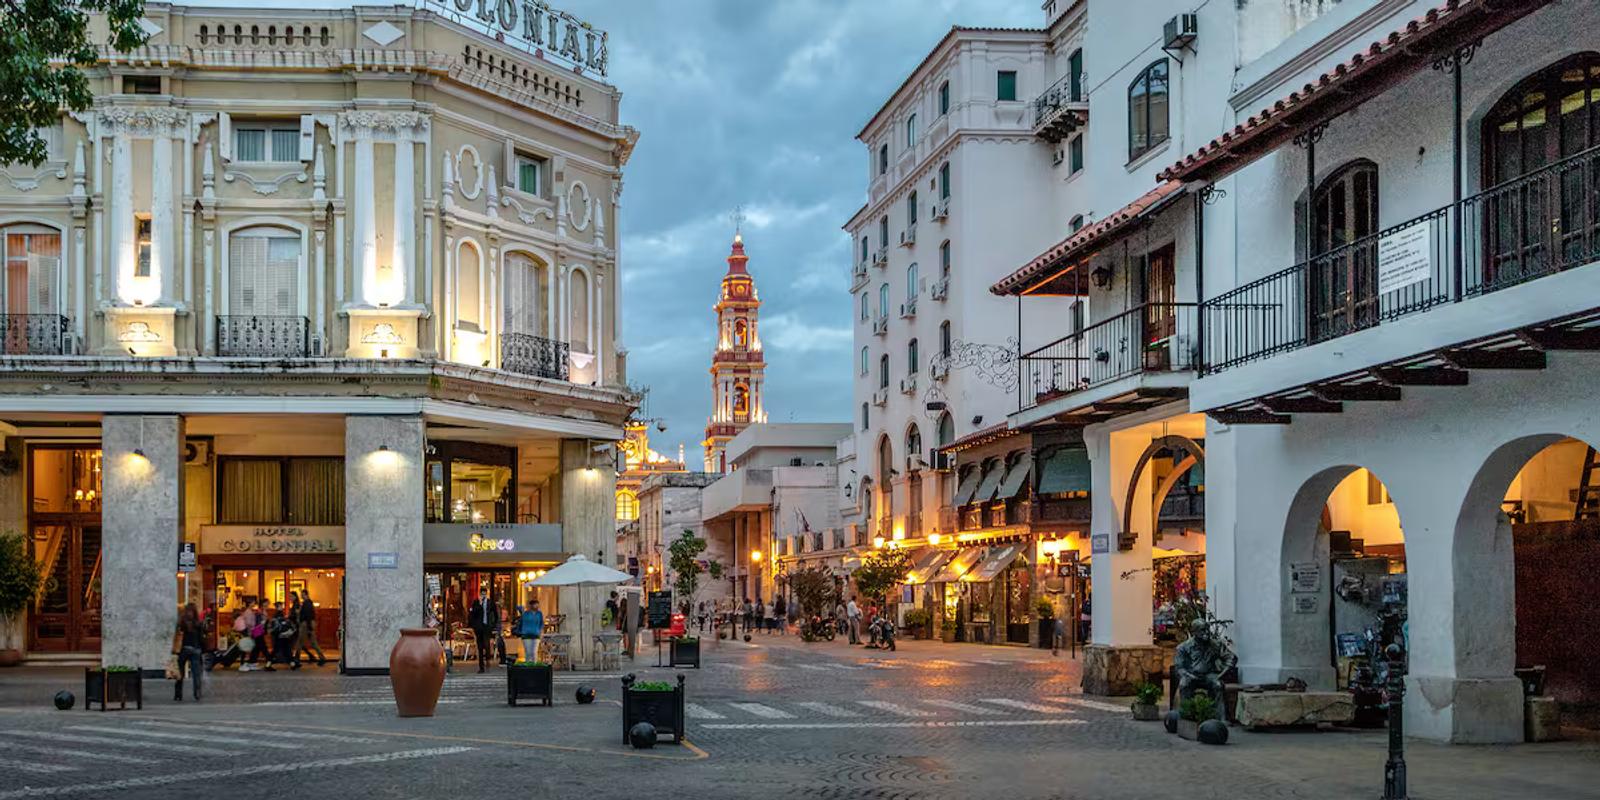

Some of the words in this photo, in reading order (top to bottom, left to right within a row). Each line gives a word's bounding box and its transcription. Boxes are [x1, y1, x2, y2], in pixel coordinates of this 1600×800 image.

[439, 0, 604, 71] LONIAL
[254, 527, 305, 537] HOTEL
[222, 539, 337, 551] COLONIAL
